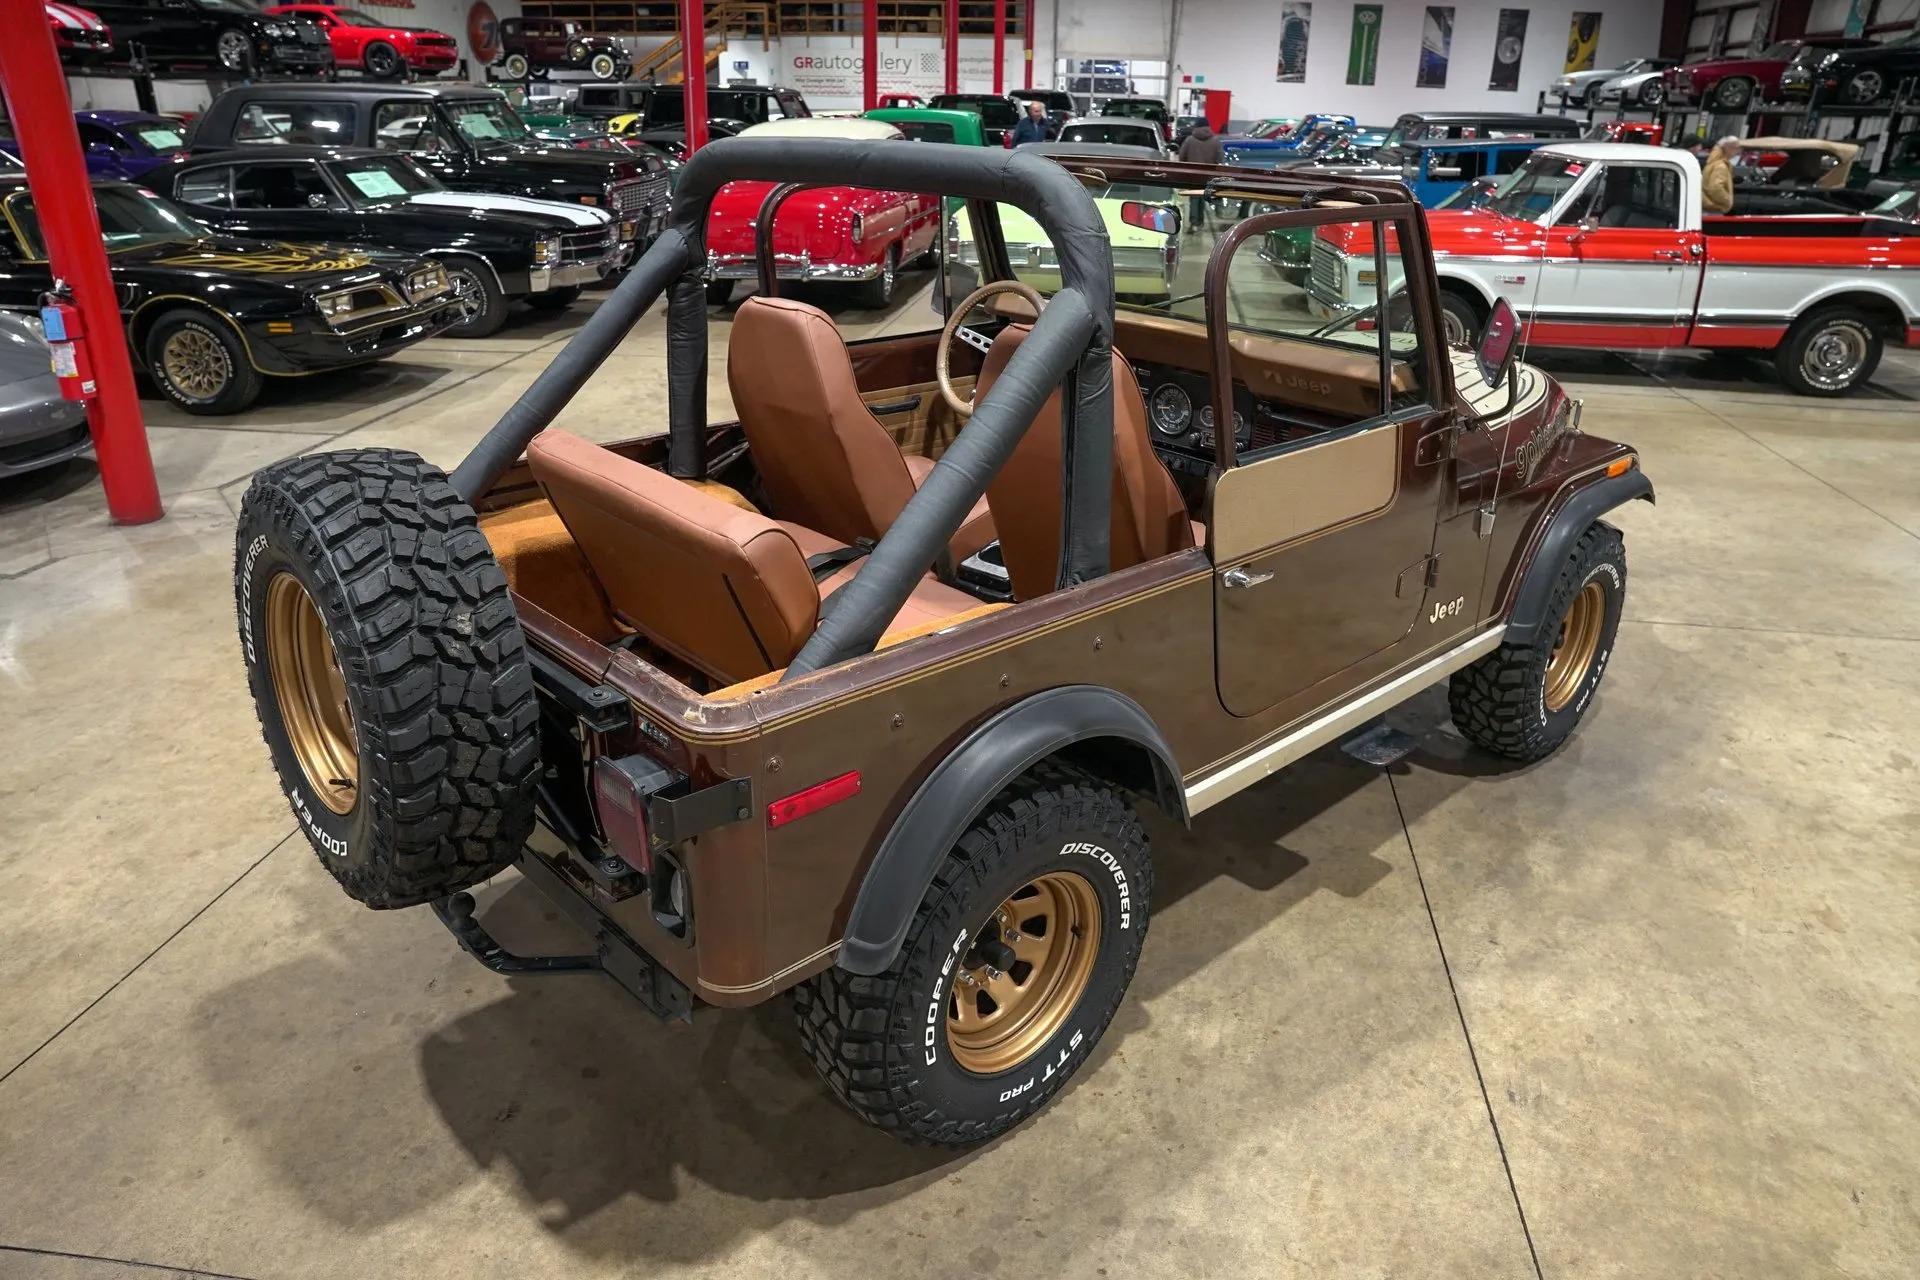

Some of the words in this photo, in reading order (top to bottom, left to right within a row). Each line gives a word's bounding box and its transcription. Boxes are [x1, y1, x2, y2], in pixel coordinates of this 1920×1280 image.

[793, 51, 912, 75] GRautoglery
[1286, 375, 1331, 396] Jeep
[242, 533, 270, 665] DISCOVERER
[1429, 596, 1464, 624] Jeep
[291, 785, 348, 857] COOPER
[1058, 842, 1132, 931] DISCOVERER
[925, 928, 969, 1067] COOPER
[1042, 1028, 1083, 1083] STT
[999, 1077, 1035, 1103] PRO
